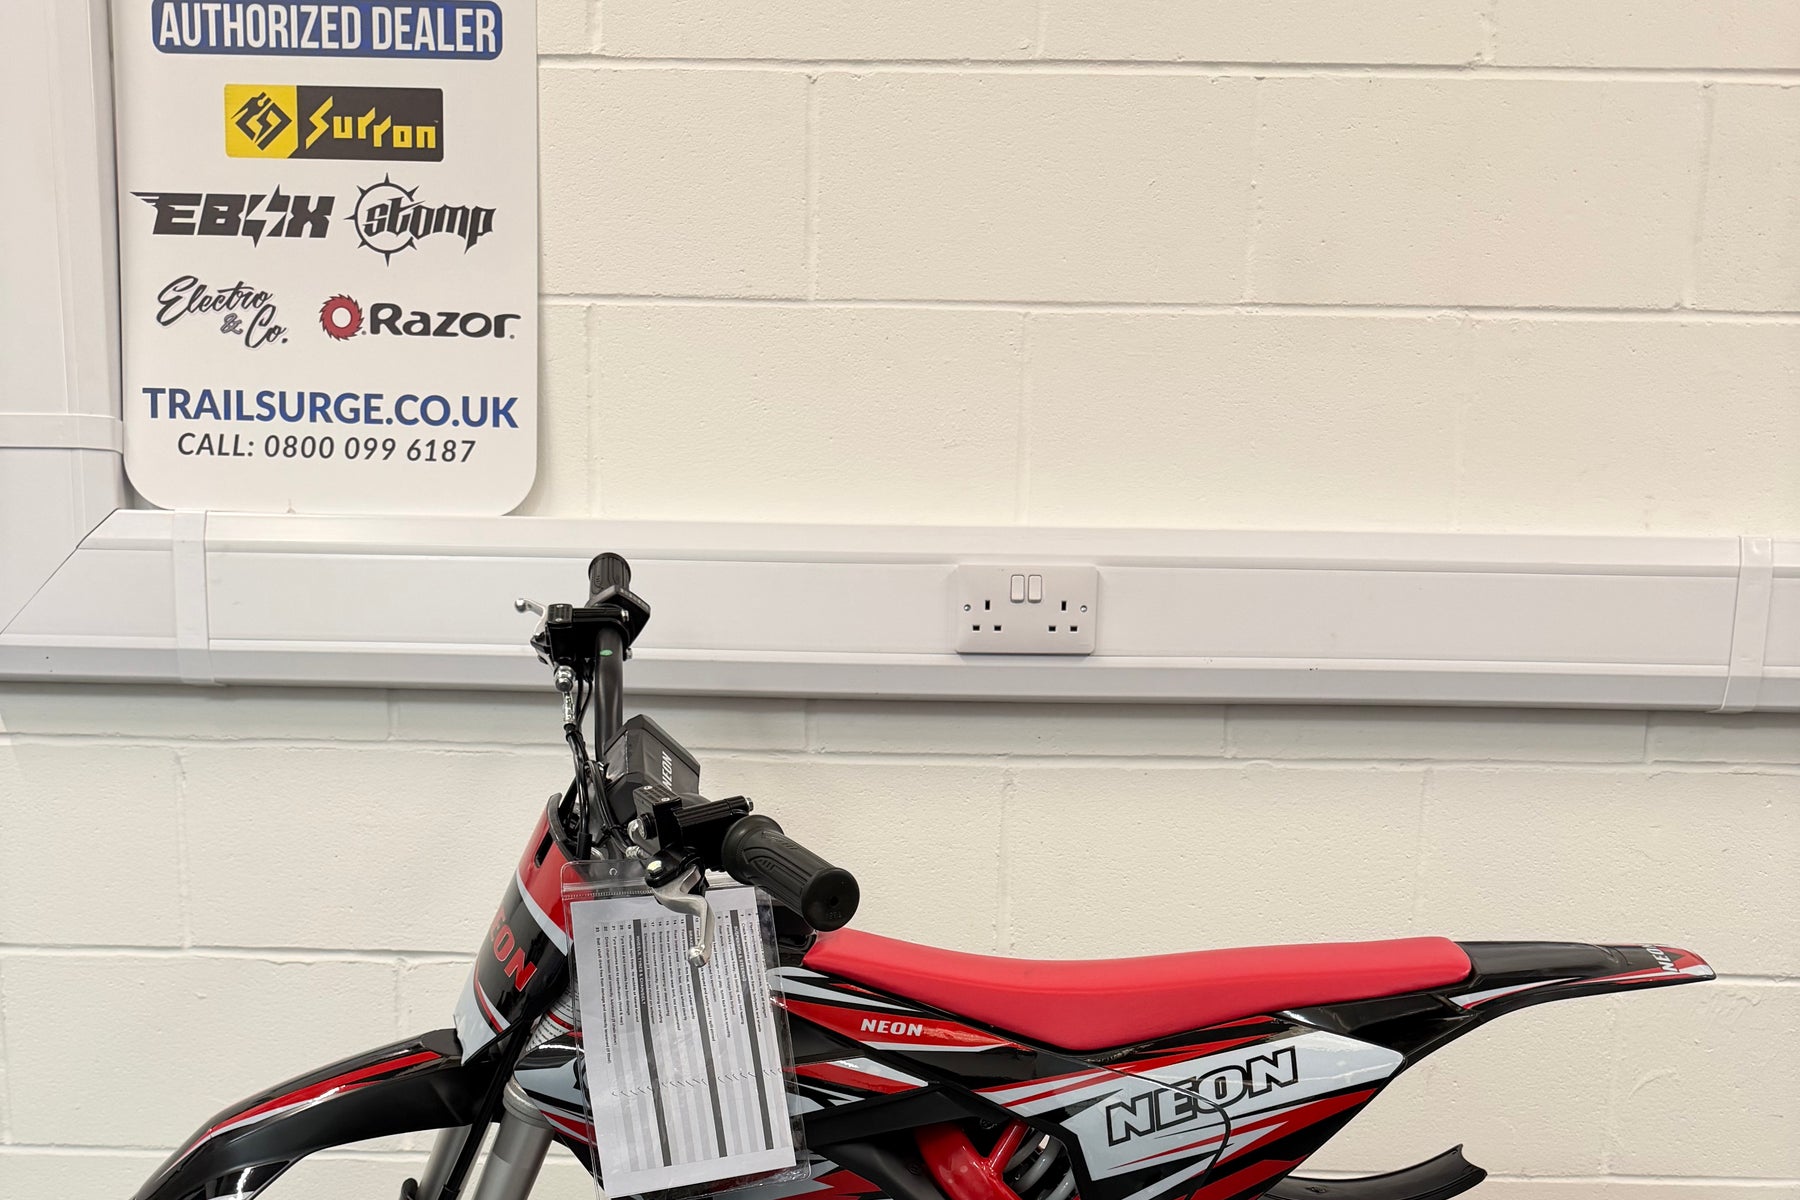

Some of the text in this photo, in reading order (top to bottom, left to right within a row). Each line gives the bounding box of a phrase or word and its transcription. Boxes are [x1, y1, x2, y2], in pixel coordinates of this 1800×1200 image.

[158, 3, 496, 52] AUTHORIZED DEALER
[156, 275, 274, 327] Electro
[220, 304, 289, 348] & Co.
[142, 387, 519, 429] TRAILSURGE.CO.UK
[177, 432, 476, 462] CALL: 0800 099 6187
[860, 1018, 923, 1037] NEON
[1106, 1046, 1299, 1147] NEON
